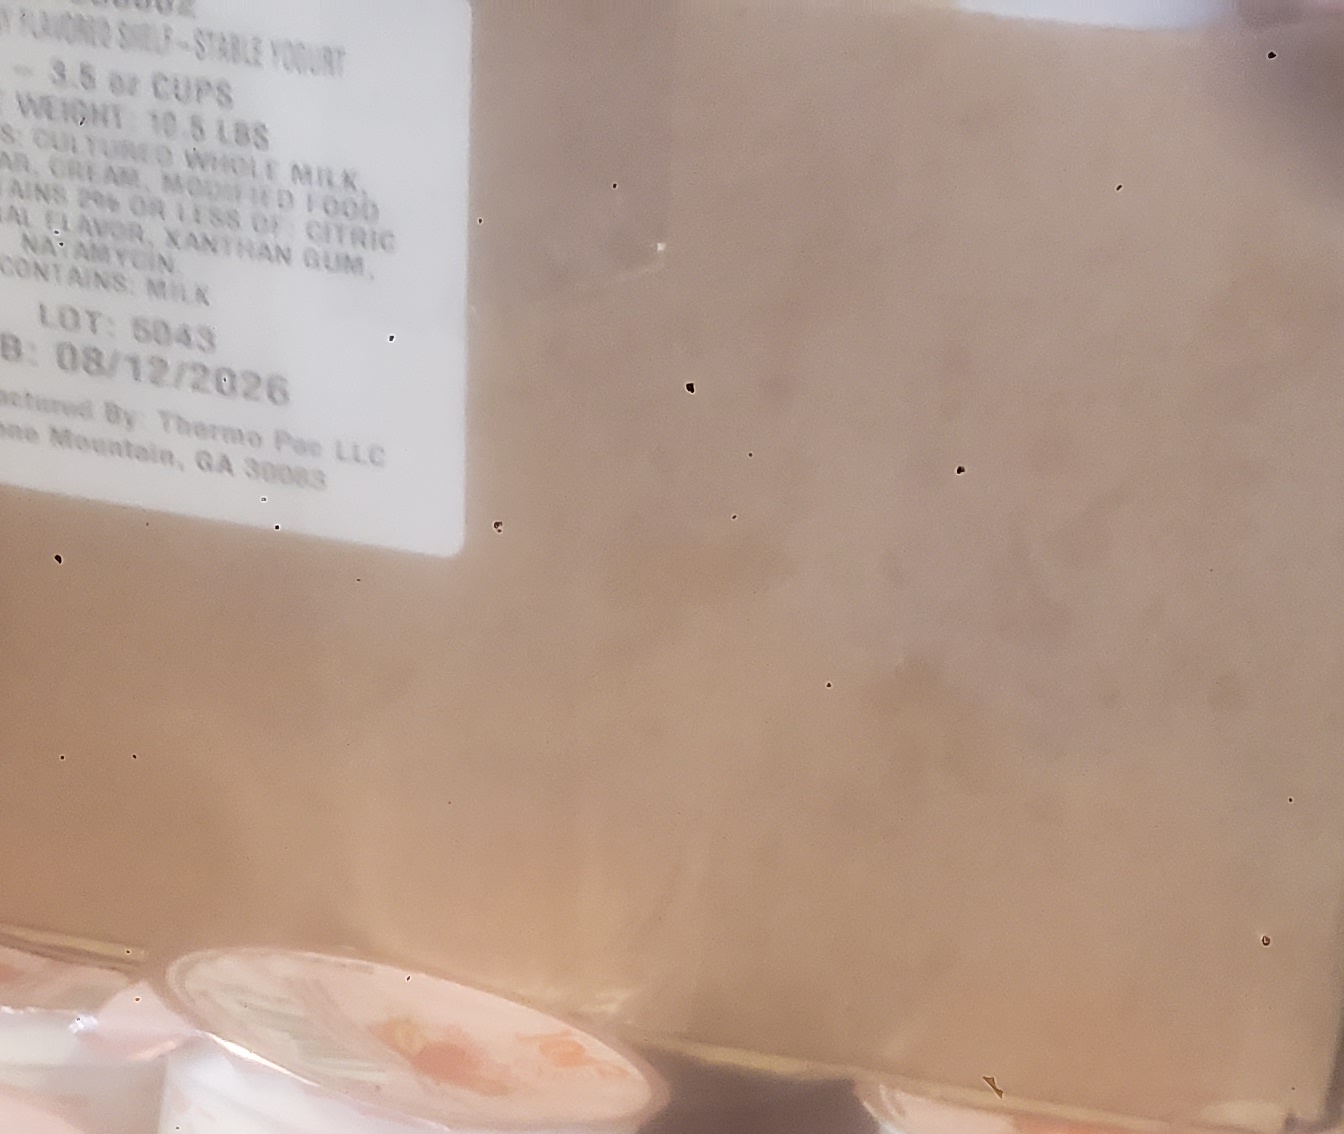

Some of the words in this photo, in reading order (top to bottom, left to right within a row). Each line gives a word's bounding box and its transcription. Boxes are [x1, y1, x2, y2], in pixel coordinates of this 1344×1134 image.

[152, 71, 233, 110] CUPS
[216, 118, 269, 151] LBS
[129, 195, 166, 222] OR
[176, 201, 241, 231] LESS
[306, 219, 396, 253] CITRIC
[307, 194, 379, 224] FOOD
[146, 275, 211, 306] MILK
[38, 300, 116, 340] LOT:
[130, 313, 217, 354] 5043
[56, 340, 290, 408] 08/12/2026
[157, 408, 263, 449] Thermo
[335, 437, 386, 468] LLC
[193, 448, 236, 477] GA
